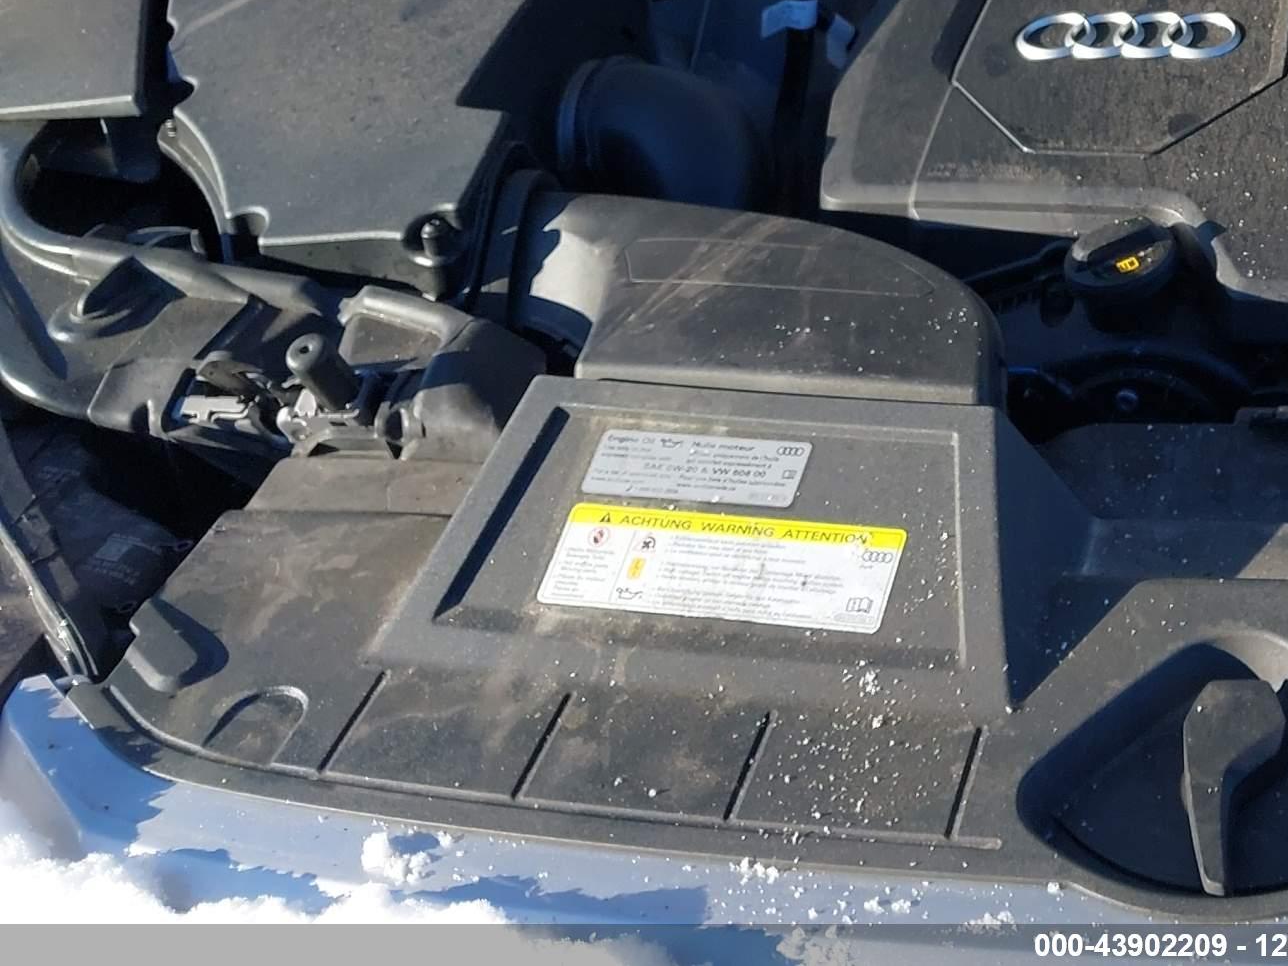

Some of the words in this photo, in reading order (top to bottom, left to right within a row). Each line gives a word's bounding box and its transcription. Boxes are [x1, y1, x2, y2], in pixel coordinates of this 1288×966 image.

[712, 466, 733, 476] VW
[620, 515, 692, 531] ACHTUNG
[700, 521, 775, 538] WARNING
[782, 529, 869, 545] ATTENTION
